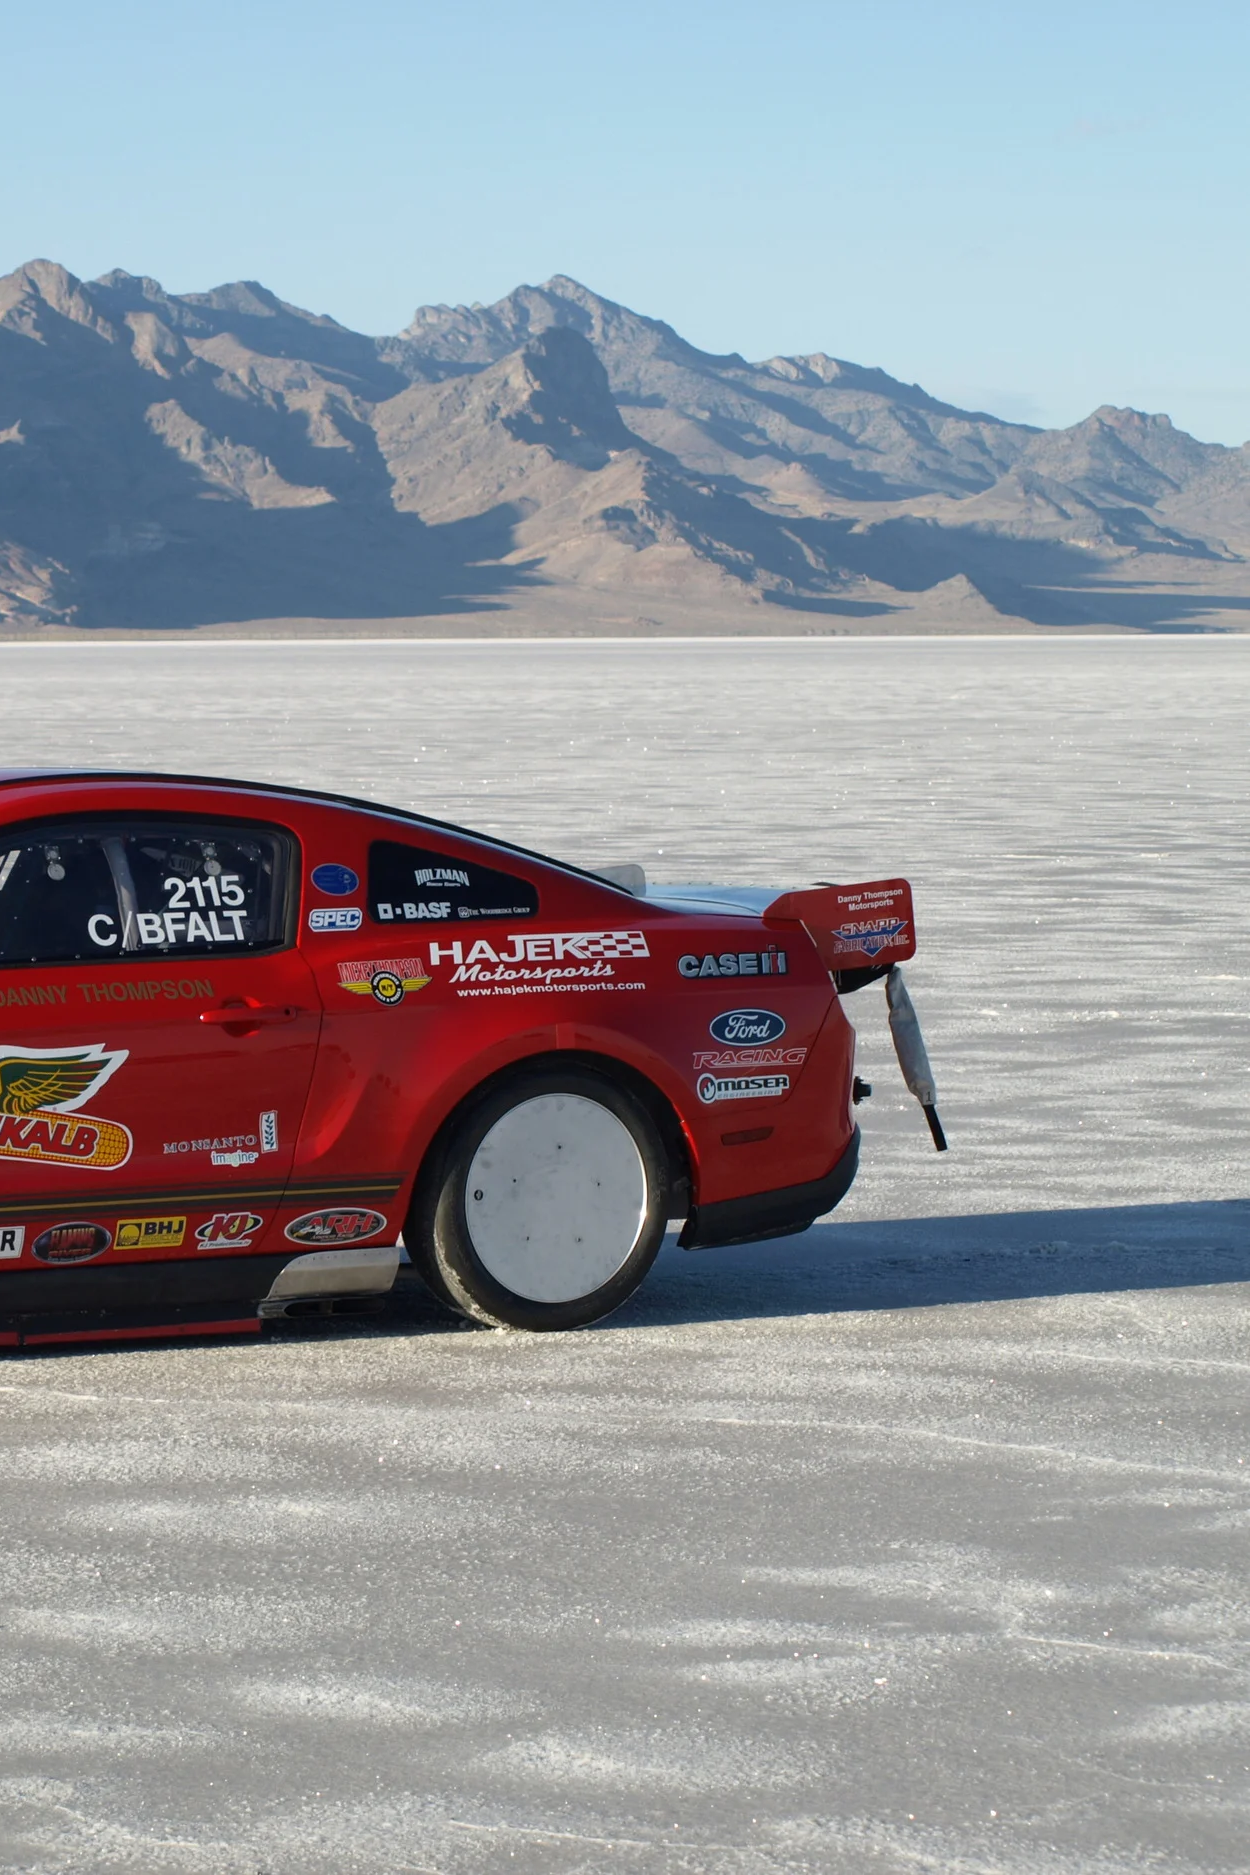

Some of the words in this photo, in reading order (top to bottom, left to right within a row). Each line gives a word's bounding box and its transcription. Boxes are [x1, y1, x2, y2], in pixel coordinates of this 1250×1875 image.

[414, 868, 470, 887] HOLZMAN
[164, 875, 245, 909] 2115
[837, 894, 862, 903] Danny
[862, 888, 903, 900] Thompson
[402, 902, 451, 919] BASF
[848, 898, 894, 911] Motorsports
[311, 911, 360, 927] SPEC
[840, 917, 900, 936] SNAPP
[429, 931, 589, 966] HAJEK
[337, 961, 373, 983] MICKEY
[370, 958, 427, 981] THOMPSON
[449, 960, 615, 984] Motorsports
[678, 953, 759, 978] CASE
[76, 979, 216, 1003] THOMPSON
[457, 981, 646, 997] www.hajekmotorsports.com
[724, 1014, 771, 1039] Ford
[693, 1047, 808, 1070] RACING
[716, 1077, 789, 1093] MOSER
[162, 1134, 257, 1154] MONSANTO
[211, 1150, 258, 1167] imagine
[144, 1220, 185, 1235] BHJ
[208, 1214, 250, 1242] KJ
[303, 1213, 375, 1236] ARH
